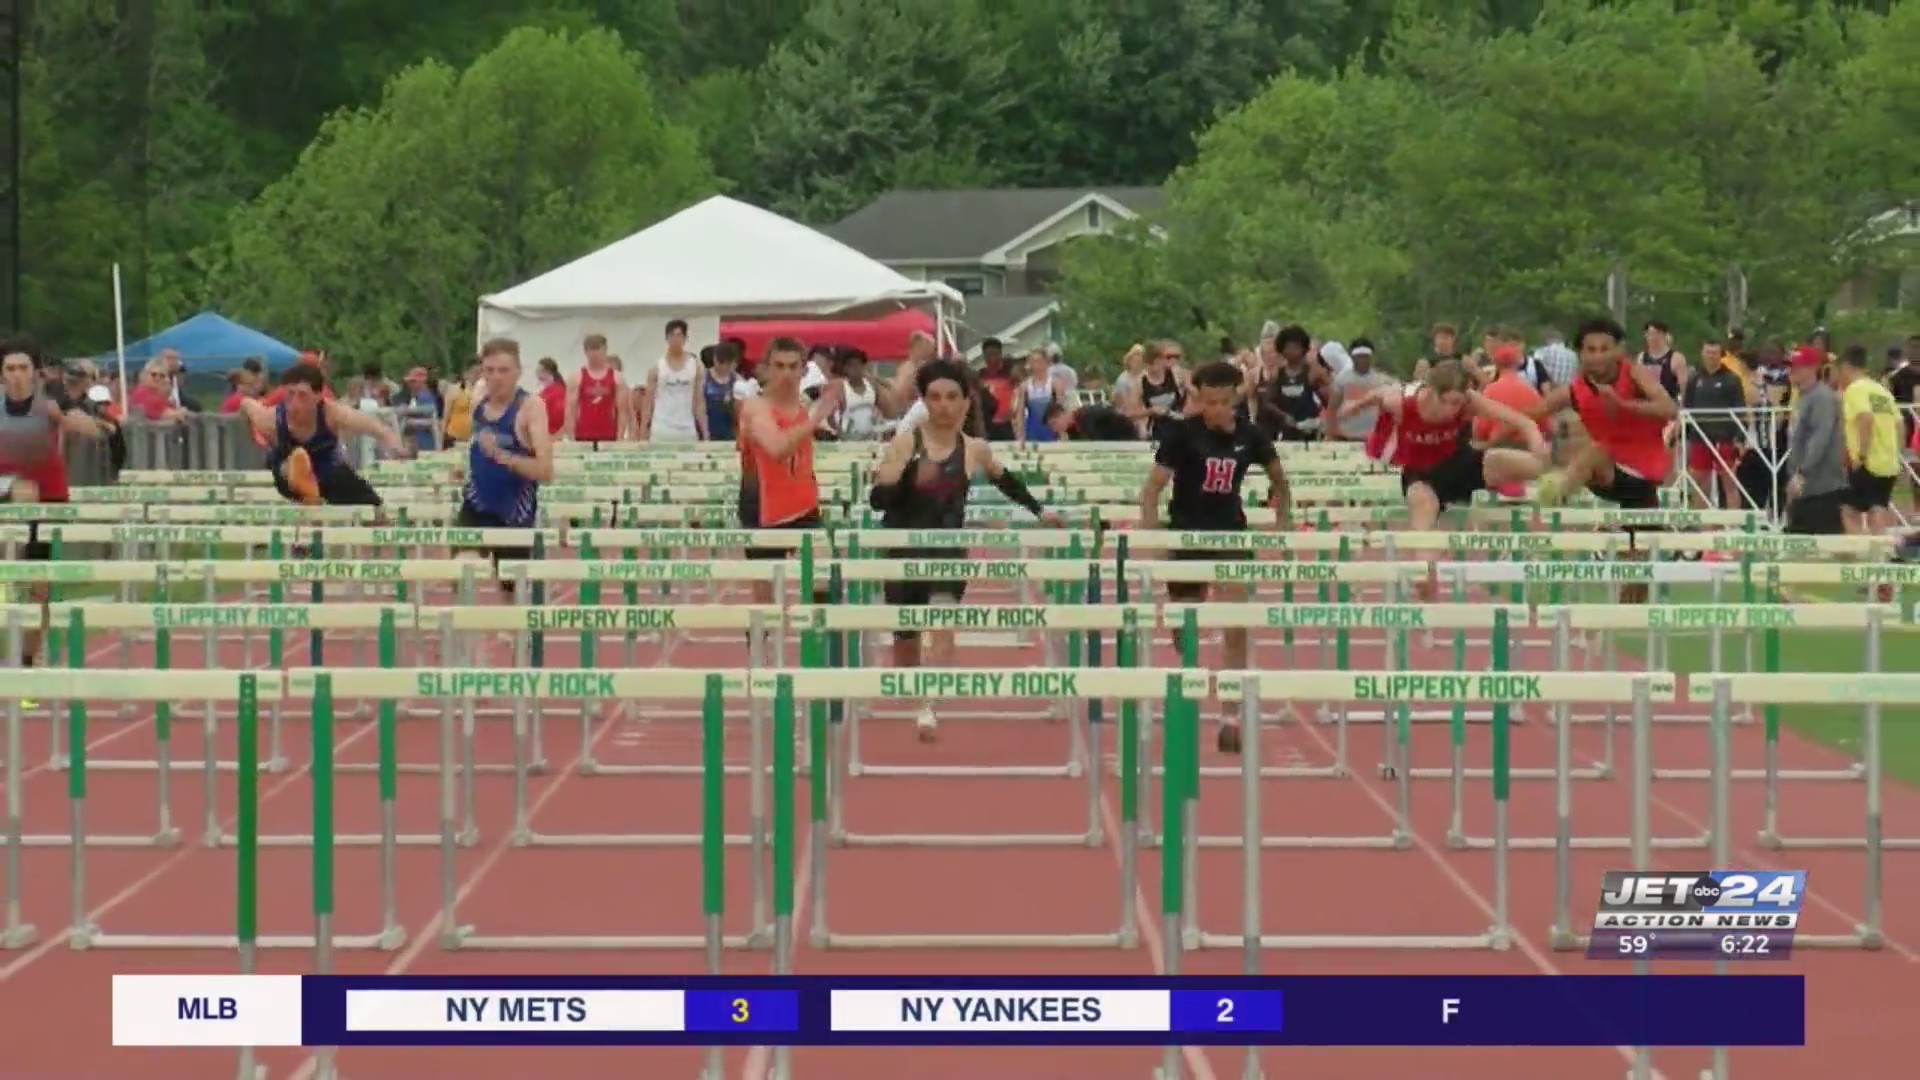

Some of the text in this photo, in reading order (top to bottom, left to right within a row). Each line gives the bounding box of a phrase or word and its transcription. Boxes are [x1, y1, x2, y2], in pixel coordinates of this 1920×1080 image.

[1203, 457, 1236, 493] H
[112, 528, 222, 541] SLIPPERY ROCK
[373, 530, 483, 543] SLIPPERY ROCK
[641, 532, 753, 545] SLIPPERY ROCK
[908, 532, 1020, 545] SLIPPERY ROCK
[1181, 534, 1286, 547] SLIPPERY ROCK
[1449, 535, 1553, 548] SLIPPERY ROCK
[1713, 537, 1819, 550] SLIPPERY ROCK
[279, 564, 402, 578] SLIPPERY ROCK
[589, 564, 712, 578] SLIPPERY ROCK
[904, 563, 1028, 577] SLIPPERY ROCK
[1215, 564, 1338, 579] SLIPPERY ROCK
[1524, 564, 1654, 579] SLIPPERY ROCK
[153, 607, 309, 625] SLIPPERY ROCK
[527, 609, 676, 627] SLIPPERY ROCK
[900, 608, 1047, 626] SLIPPERY ROCK
[1267, 606, 1425, 625] SLIPPERY ROCK
[1648, 608, 1795, 626] SLIPPERY ROCK
[418, 672, 616, 697] SLIPPERY ROCK
[880, 672, 1078, 697] SLIPPERY ROCK
[1354, 675, 1541, 699] SLIPPERY ROCK
